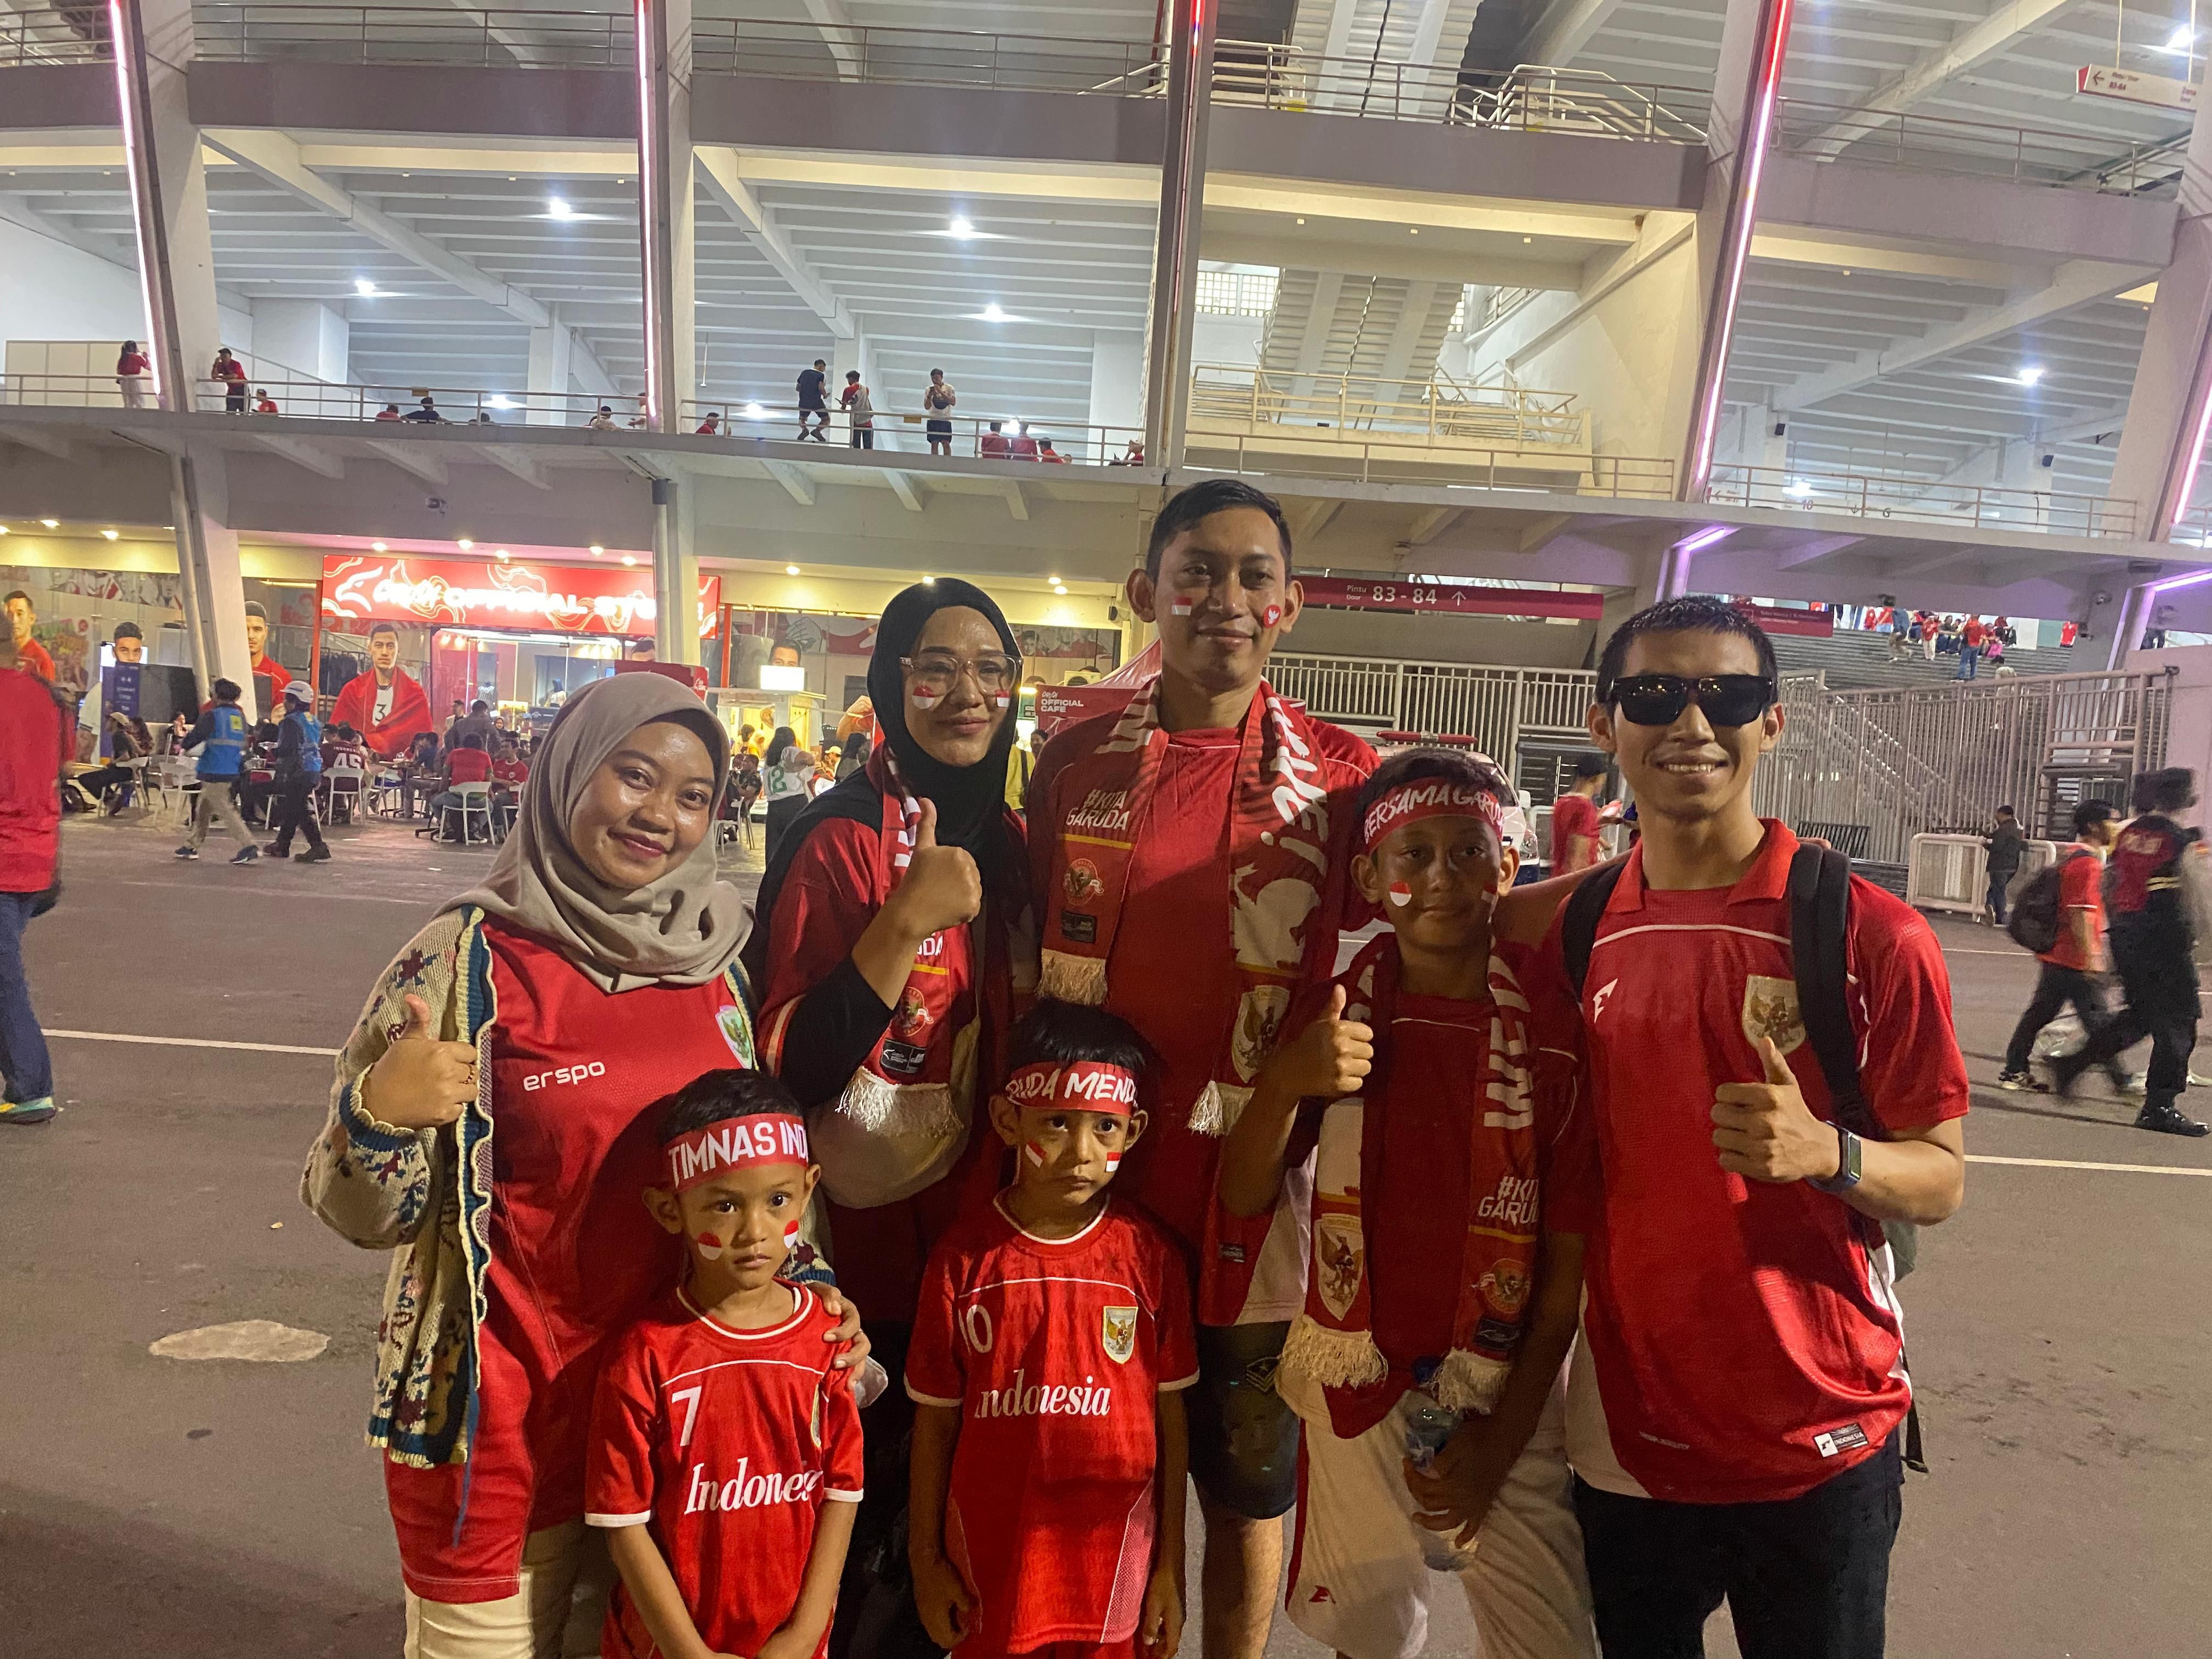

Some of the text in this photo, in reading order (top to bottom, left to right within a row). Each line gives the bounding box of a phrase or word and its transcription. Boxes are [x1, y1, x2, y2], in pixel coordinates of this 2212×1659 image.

[1347, 585, 1367, 593] Pintu
[1373, 586, 1396, 602] 83
[1413, 588, 1437, 605] 84
[1041, 699, 1084, 707] OFFICIAL
[334, 753, 362, 769] 45
[1065, 807, 1130, 831] GARUDA
[523, 1062, 606, 1091] erspo
[668, 1122, 777, 1188] TIMNAS
[974, 1368, 1111, 1419] ndonesia
[671, 1385, 702, 1447] 7
